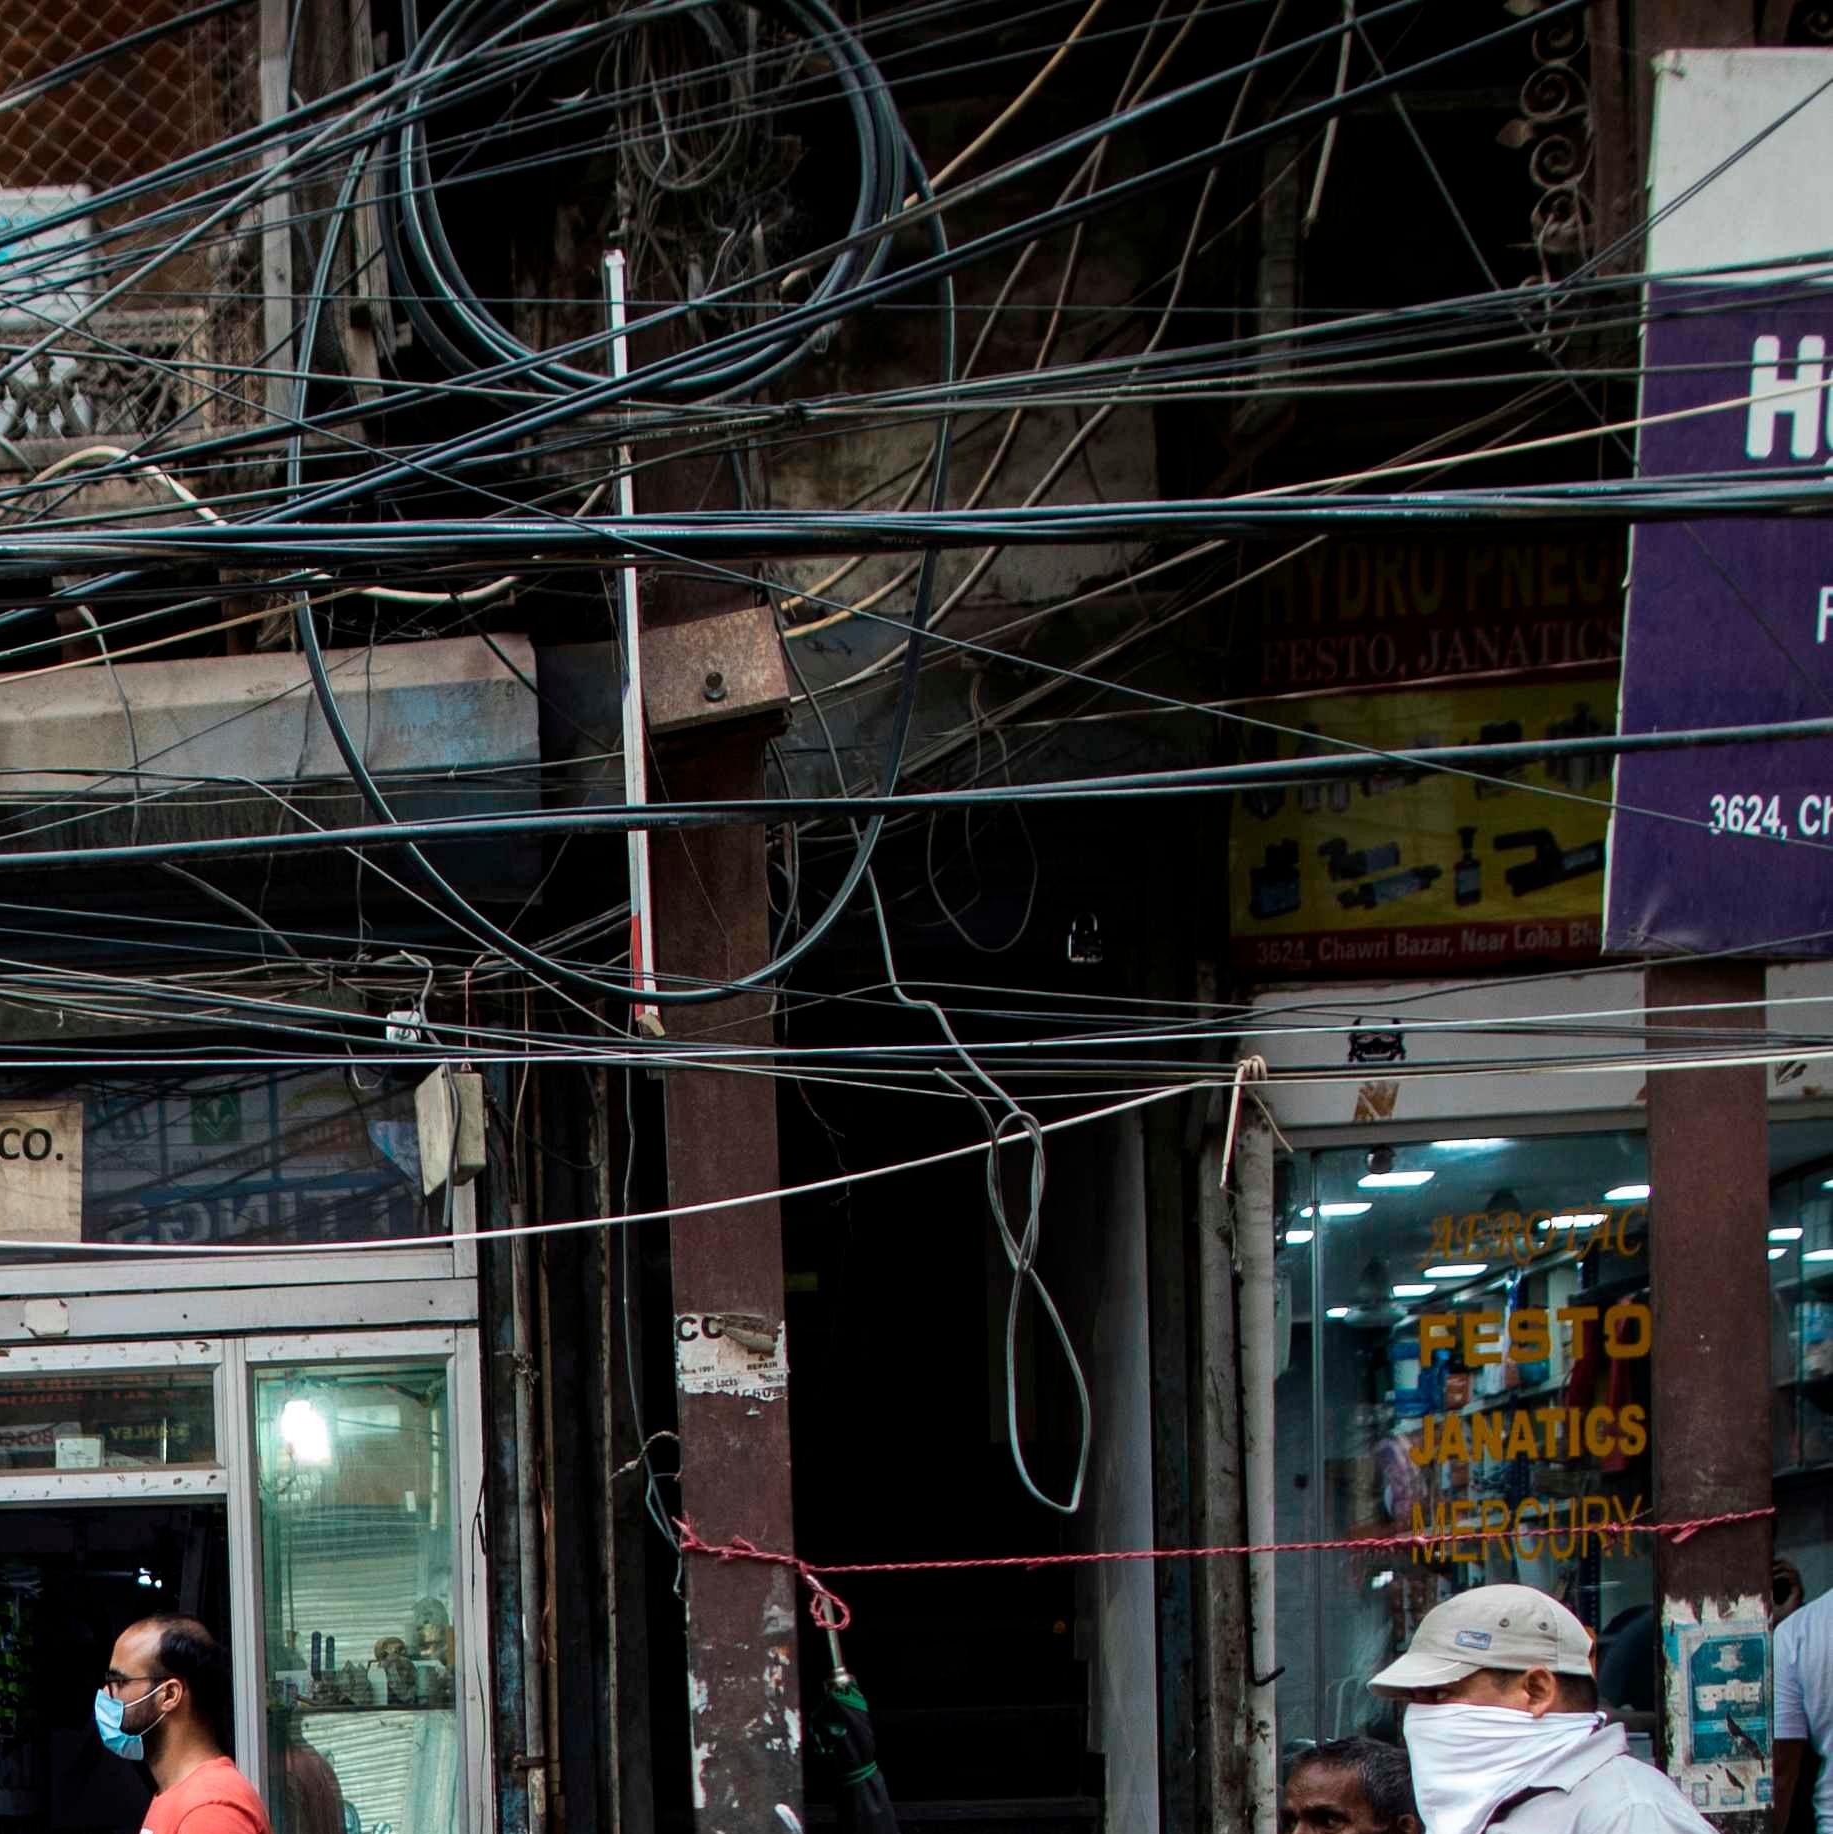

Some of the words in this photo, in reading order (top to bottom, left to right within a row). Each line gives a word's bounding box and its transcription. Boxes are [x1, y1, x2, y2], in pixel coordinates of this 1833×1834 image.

[1746, 334, 1833, 458] H
[1260, 633, 1411, 688] FESTO,
[1709, 794, 1788, 841] 3624,
[1318, 938, 1390, 963] Chawri
[1395, 931, 1454, 960] Bazar,
[1461, 927, 1508, 953] Near
[1514, 923, 1563, 949] Loha
[1420, 1305, 1652, 1367] FESTO
[1410, 1402, 1648, 1466] JANATICS
[1412, 1495, 1646, 1564] MERCURY
